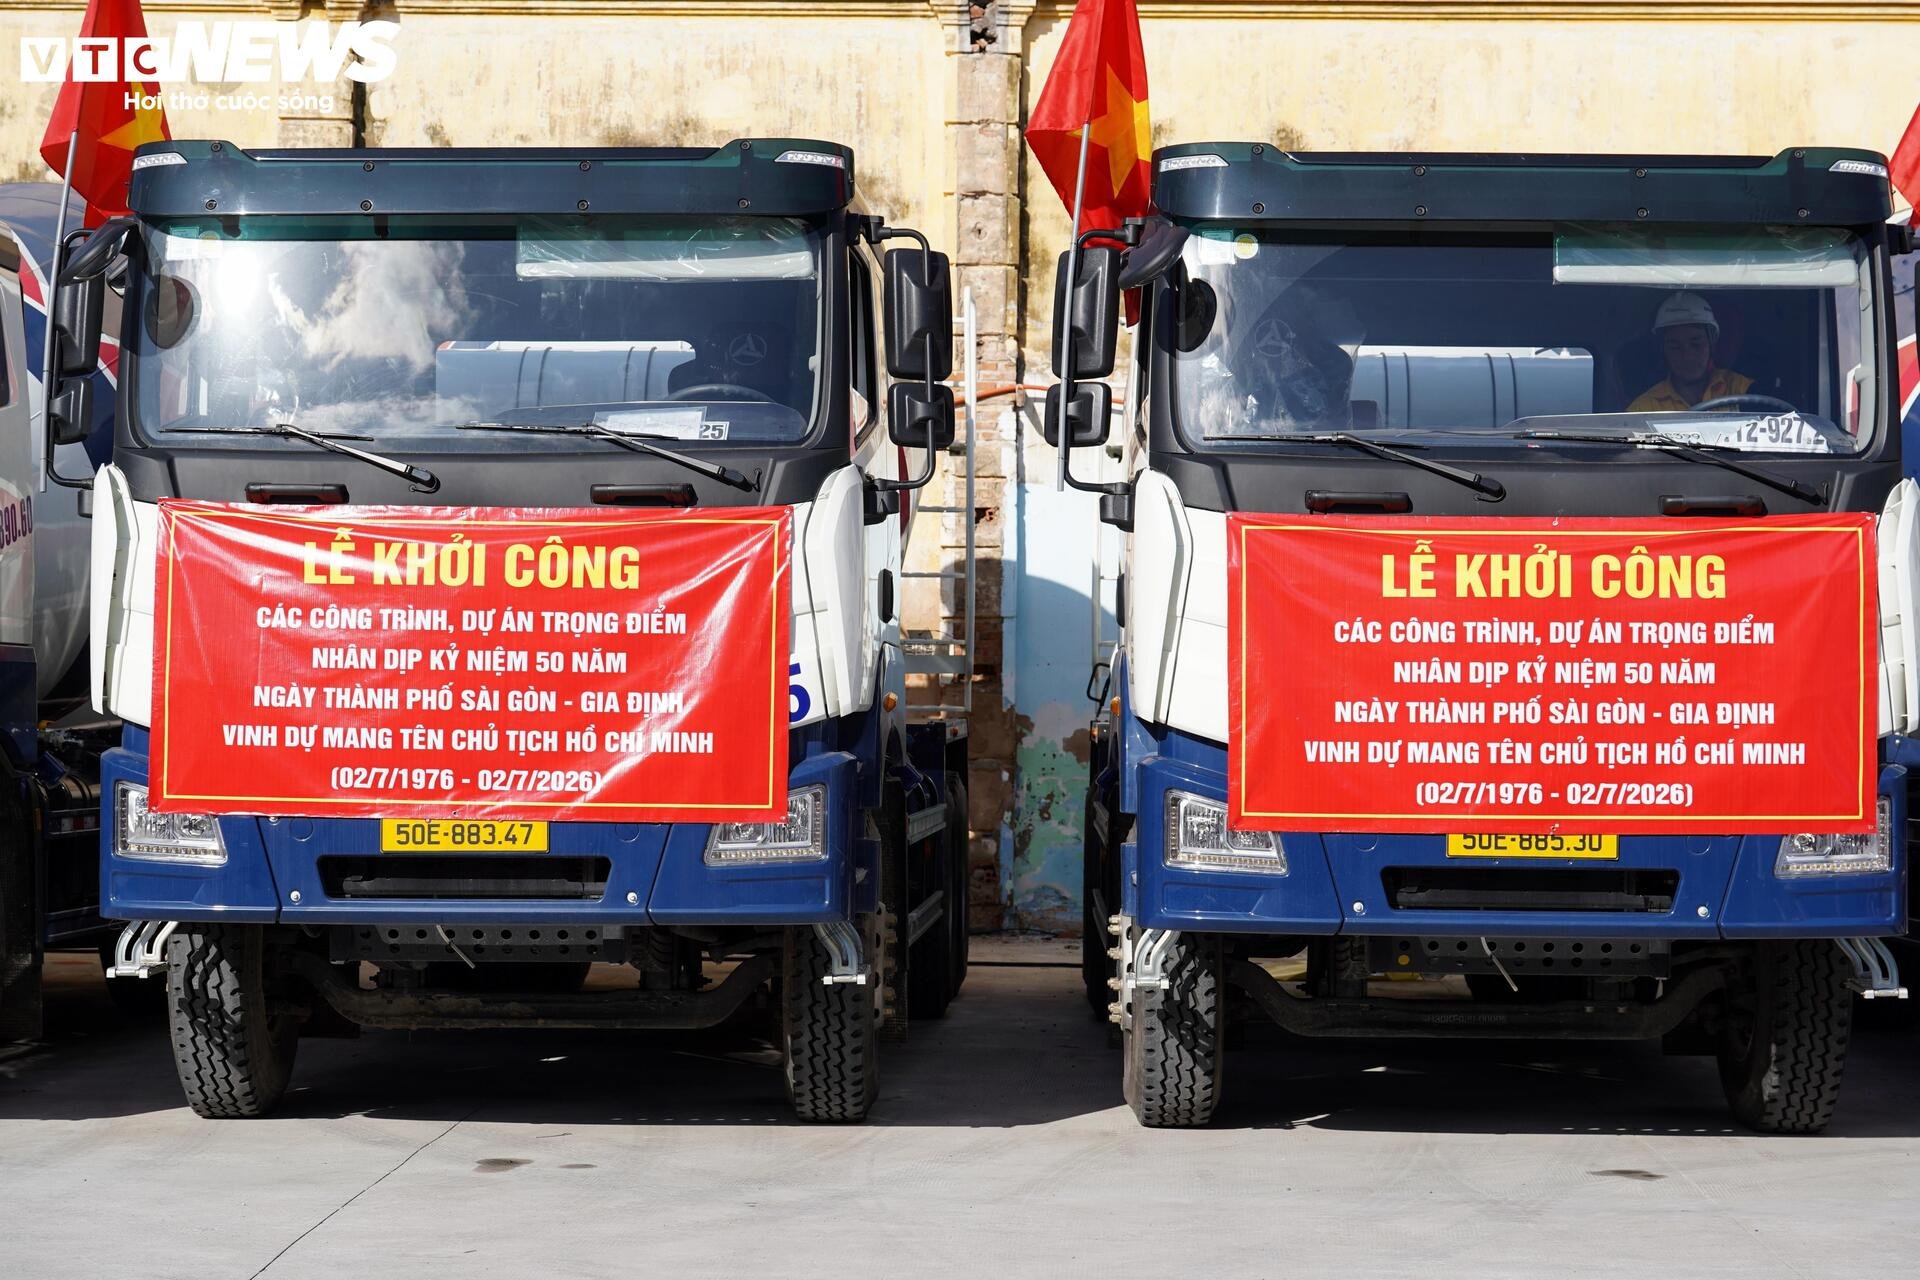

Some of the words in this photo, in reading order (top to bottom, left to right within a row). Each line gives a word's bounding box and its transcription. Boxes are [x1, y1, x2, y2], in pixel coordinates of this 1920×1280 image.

[303, 527, 355, 585] LỄ
[373, 533, 487, 587] KHỞI
[504, 535, 640, 590] CÔNG
[1382, 539, 1437, 598] LỄ
[1455, 543, 1572, 598] KHỞI
[1591, 545, 1727, 599] CÔNG
[256, 602, 303, 629] CÁC
[310, 604, 373, 630] CÔNG
[379, 604, 454, 634] TRÌNH,
[462, 608, 497, 637] DỰ
[501, 606, 533, 632] ÁN
[541, 610, 619, 638] TRỌNG
[626, 604, 687, 634] ĐIỂM
[1334, 616, 1382, 643] CÁC
[1390, 616, 1456, 643] CÔNG
[1463, 617, 1542, 646] TRÌNH,
[1549, 619, 1584, 648] DỰ
[1588, 617, 1622, 644] ÁN
[1629, 621, 1707, 649] TRỌNG
[1714, 613, 1775, 644] ĐIỂM
[312, 643, 377, 670] NHÂN
[384, 647, 423, 675] DỊP
[429, 642, 460, 671] KỶ
[467, 646, 529, 676] NIỆM
[535, 650, 564, 673] 50
[572, 647, 627, 673] NĂM
[1393, 657, 1461, 683] NHÂN
[1469, 661, 1509, 689] DỊP
[1516, 654, 1548, 683] KỶ
[1555, 657, 1617, 689] NIỆM
[1624, 662, 1654, 684] 50
[1660, 657, 1716, 684] NĂM
[253, 682, 317, 708] NGÀY
[323, 683, 399, 710] THÀNH
[406, 681, 454, 711] PHỐ
[461, 685, 500, 712] SÀI
[507, 685, 557, 713] GÒN
[580, 690, 620, 713] GIA
[626, 691, 684, 718] ĐỊNH
[1334, 696, 1399, 723] NGÀY
[1406, 697, 1485, 724] THÀNH
[1493, 694, 1542, 724] PHỐ
[1549, 698, 1589, 724] SÀI
[1596, 697, 1645, 724] GÒN
[1669, 702, 1709, 725] GIA
[1716, 702, 1775, 729] ĐỊNH
[223, 724, 278, 748] VINH
[285, 724, 318, 753] DỰ
[323, 726, 393, 749] MANG
[400, 724, 445, 750] TÊN
[451, 723, 498, 751] CHỦ
[506, 730, 558, 756] TỊCH
[566, 724, 597, 752] HỒ
[651, 731, 714, 753] MINH
[1304, 740, 1360, 763] VINH
[1368, 739, 1403, 768] DỰ
[1407, 742, 1480, 764] MANG
[1487, 738, 1532, 764] TÊN
[1540, 736, 1587, 765] CHỦ
[1595, 743, 1648, 769] TỊCH
[1655, 736, 1687, 765] HỒ
[1694, 738, 1735, 765] CHÍ
[1742, 743, 1806, 765] MINH
[331, 766, 454, 791] (02/7/1976
[478, 769, 601, 793] 02/7/2026)
[1416, 781, 1543, 806] (02/7/1976
[1567, 783, 1694, 807] 02/7/2026)
[396, 823, 533, 845] 50E-883.47
[1462, 834, 1603, 852] 50E-885.30
